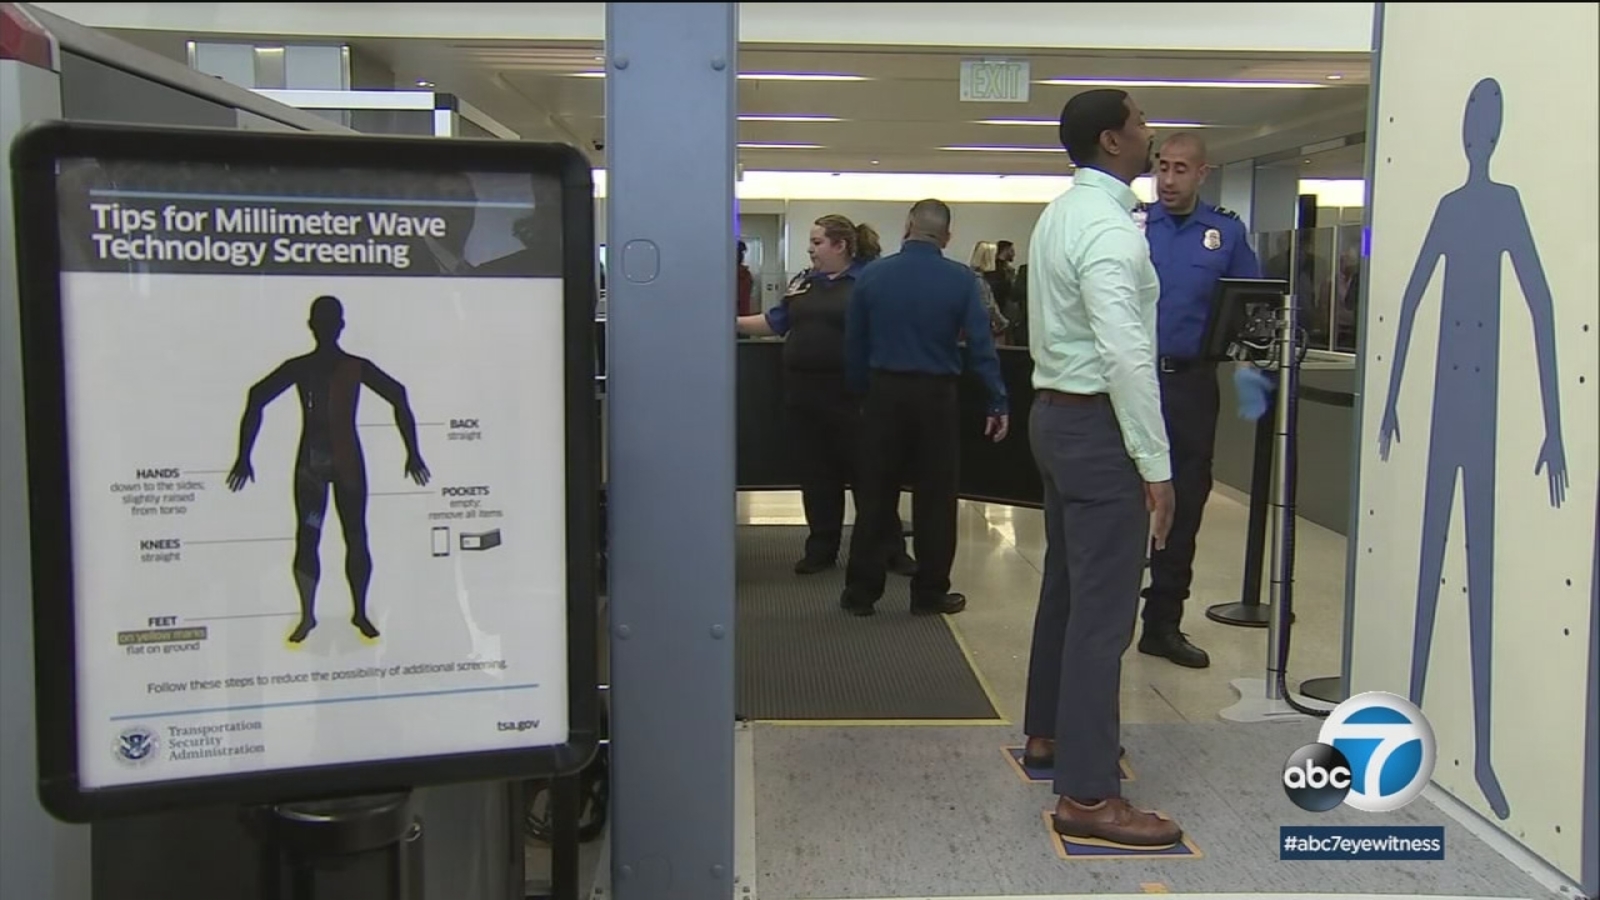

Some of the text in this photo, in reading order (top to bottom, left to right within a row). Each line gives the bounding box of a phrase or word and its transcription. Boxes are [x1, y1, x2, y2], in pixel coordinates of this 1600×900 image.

[971, 63, 1021, 99] EXIT
[90, 203, 446, 237] Tips for Millimeter Wave
[92, 233, 411, 269] Technology Screening
[450, 419, 480, 429] BACK
[447, 431, 481, 441] straight
[136, 468, 180, 479] HANDS
[110, 483, 141, 492] down
[143, 482, 155, 491] to
[156, 481, 174, 491] the
[442, 486, 490, 496] POCKETS
[122, 493, 160, 505] slightly
[131, 505, 187, 516] from torso
[428, 510, 503, 520] remove all items
[140, 539, 180, 550] KNEES
[141, 551, 181, 563] straight
[148, 616, 177, 627] FEET
[126, 642, 200, 655] flat on ground
[147, 682, 187, 693] Follow
[190, 679, 221, 690] these
[224, 677, 255, 688] steps
[257, 675, 269, 685] to
[271, 673, 308, 684] reduce
[310, 671, 329, 681] the
[331, 667, 387, 681] possibility
[389, 665, 401, 676] of
[402, 662, 455, 675] additional
[168, 720, 263, 737] Transportation
[497, 719, 540, 731] tsa.gov
[169, 735, 222, 749] Security
[169, 743, 265, 761] Administration
